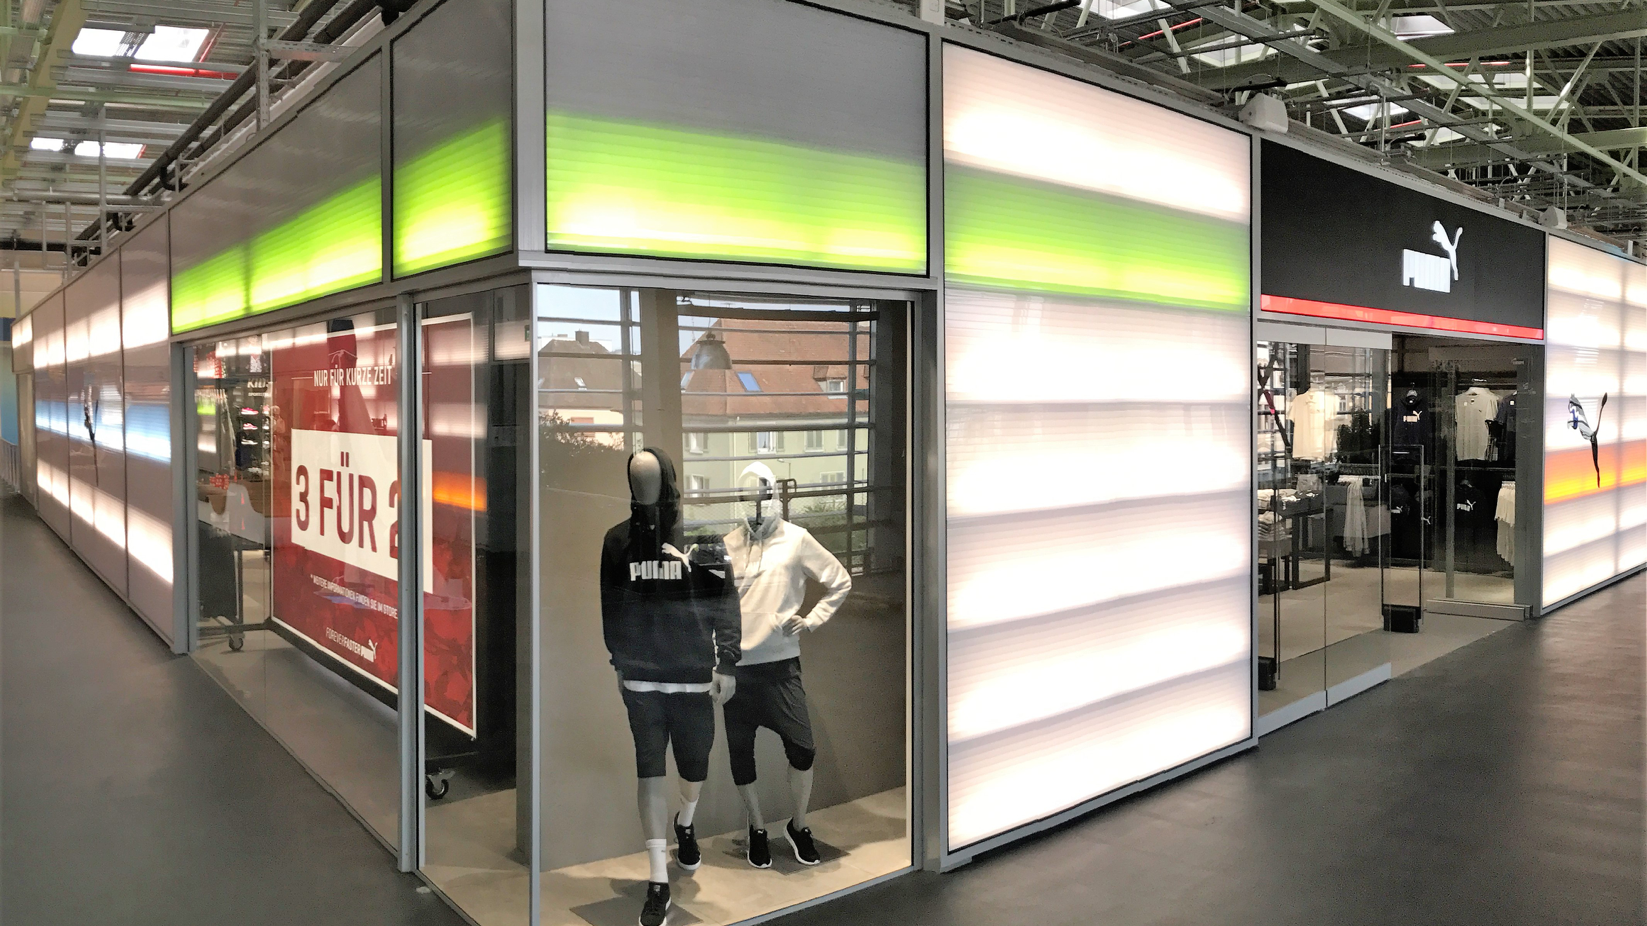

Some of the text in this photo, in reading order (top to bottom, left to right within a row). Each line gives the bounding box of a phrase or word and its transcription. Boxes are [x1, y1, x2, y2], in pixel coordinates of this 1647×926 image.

[314, 364, 392, 387] NUR FÜR KURZE ZEIT
[296, 464, 309, 531] 3
[319, 451, 377, 553] FÜR
[629, 560, 682, 581] PUMA
